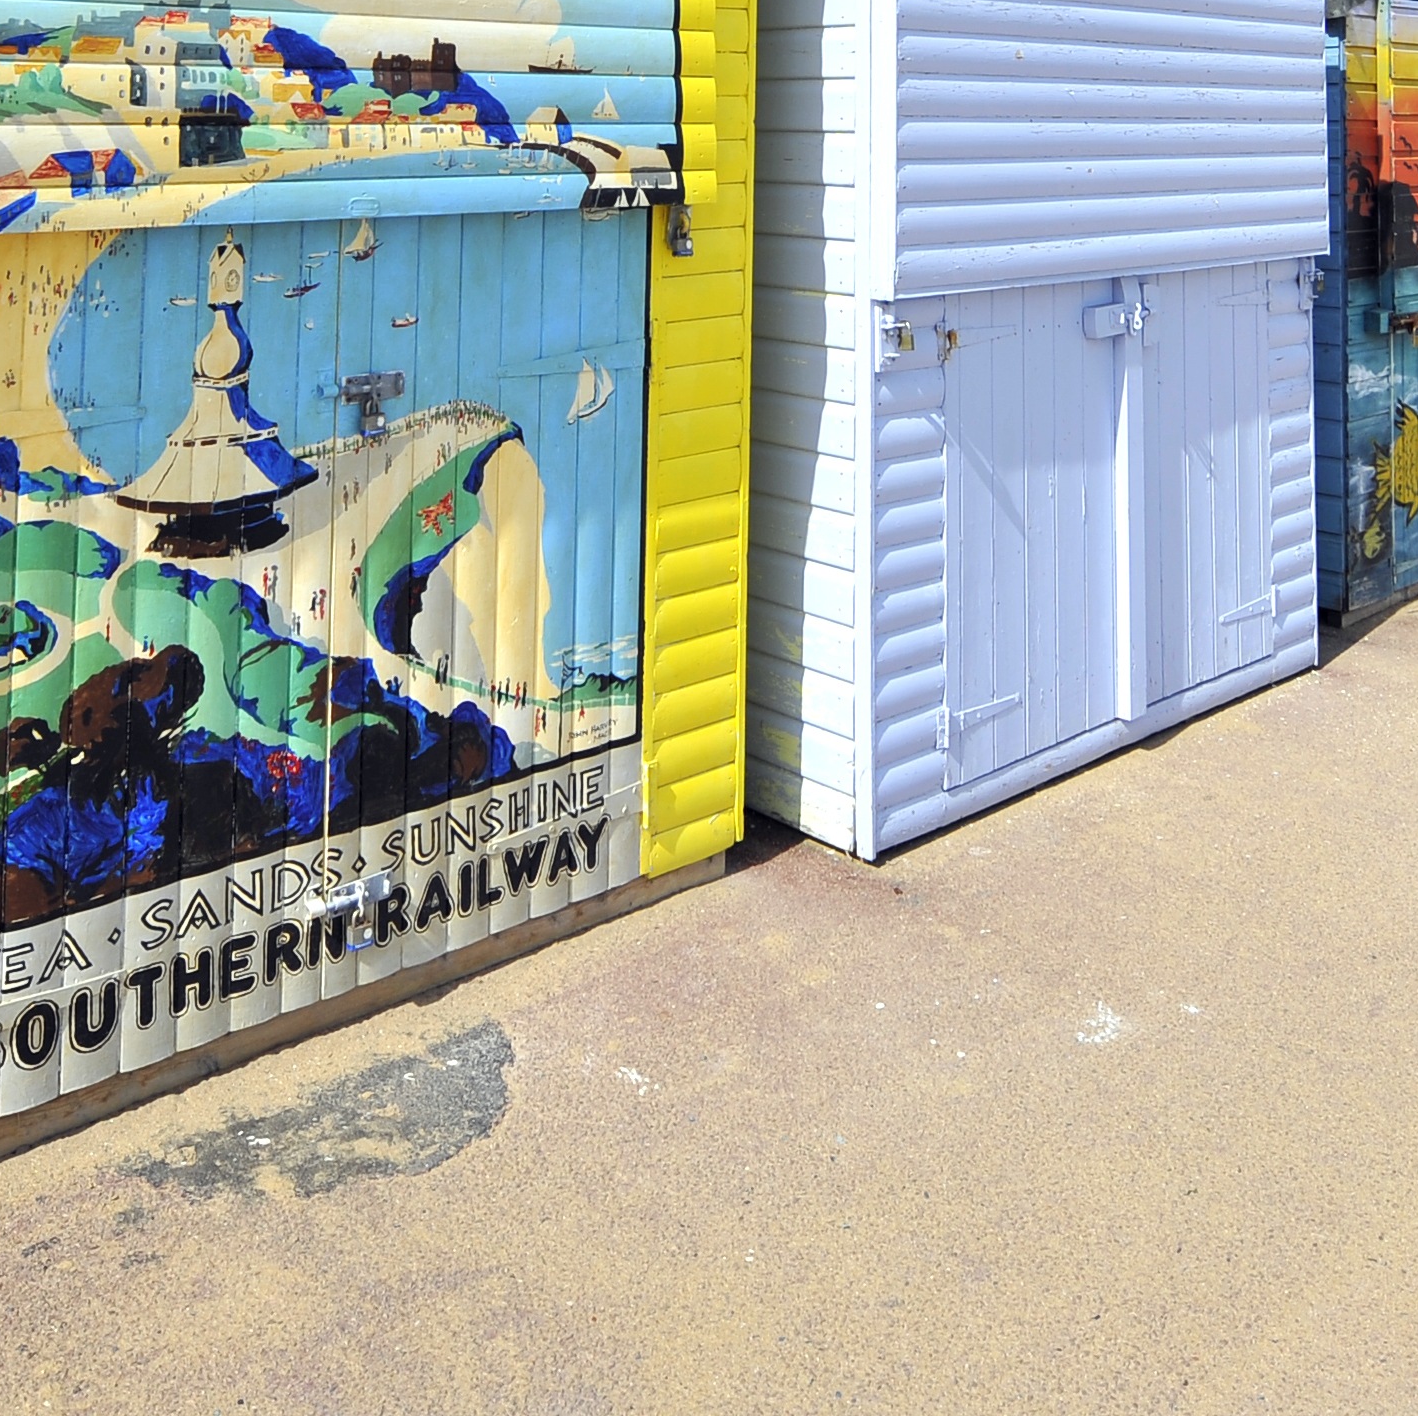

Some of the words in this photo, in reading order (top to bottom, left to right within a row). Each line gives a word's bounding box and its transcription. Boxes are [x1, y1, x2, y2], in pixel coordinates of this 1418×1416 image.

[140, 847, 343, 951] SANDS
[380, 763, 605, 872] SUNSHINE
[374, 813, 612, 948] RAILWAY
